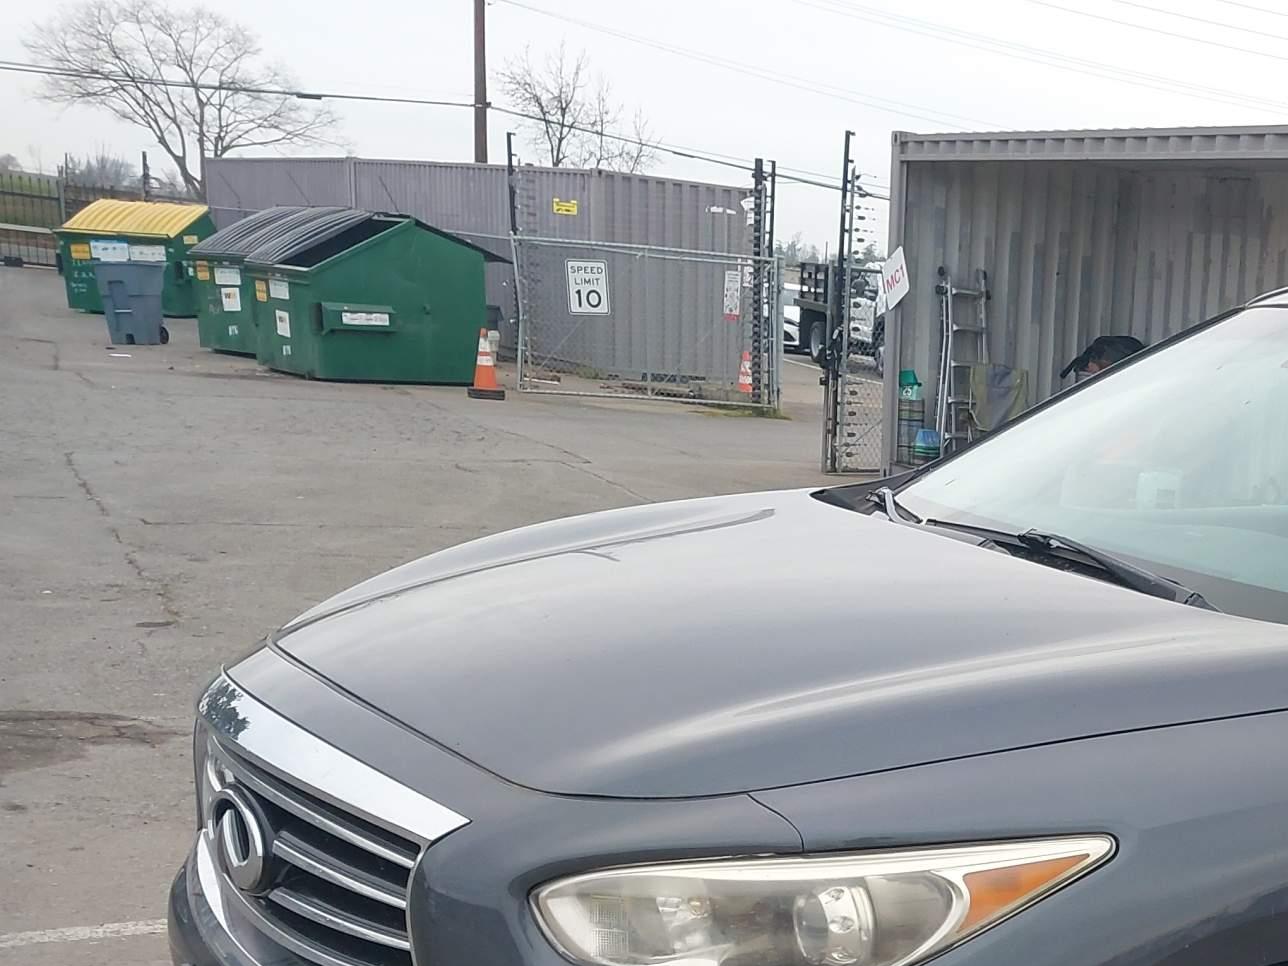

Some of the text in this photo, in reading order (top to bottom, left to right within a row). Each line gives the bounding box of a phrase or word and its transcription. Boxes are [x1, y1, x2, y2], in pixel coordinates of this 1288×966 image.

[570, 266, 603, 274] SPEED
[574, 278, 600, 286] LIMIT
[886, 263, 905, 293] MC1
[575, 289, 602, 309] 10
